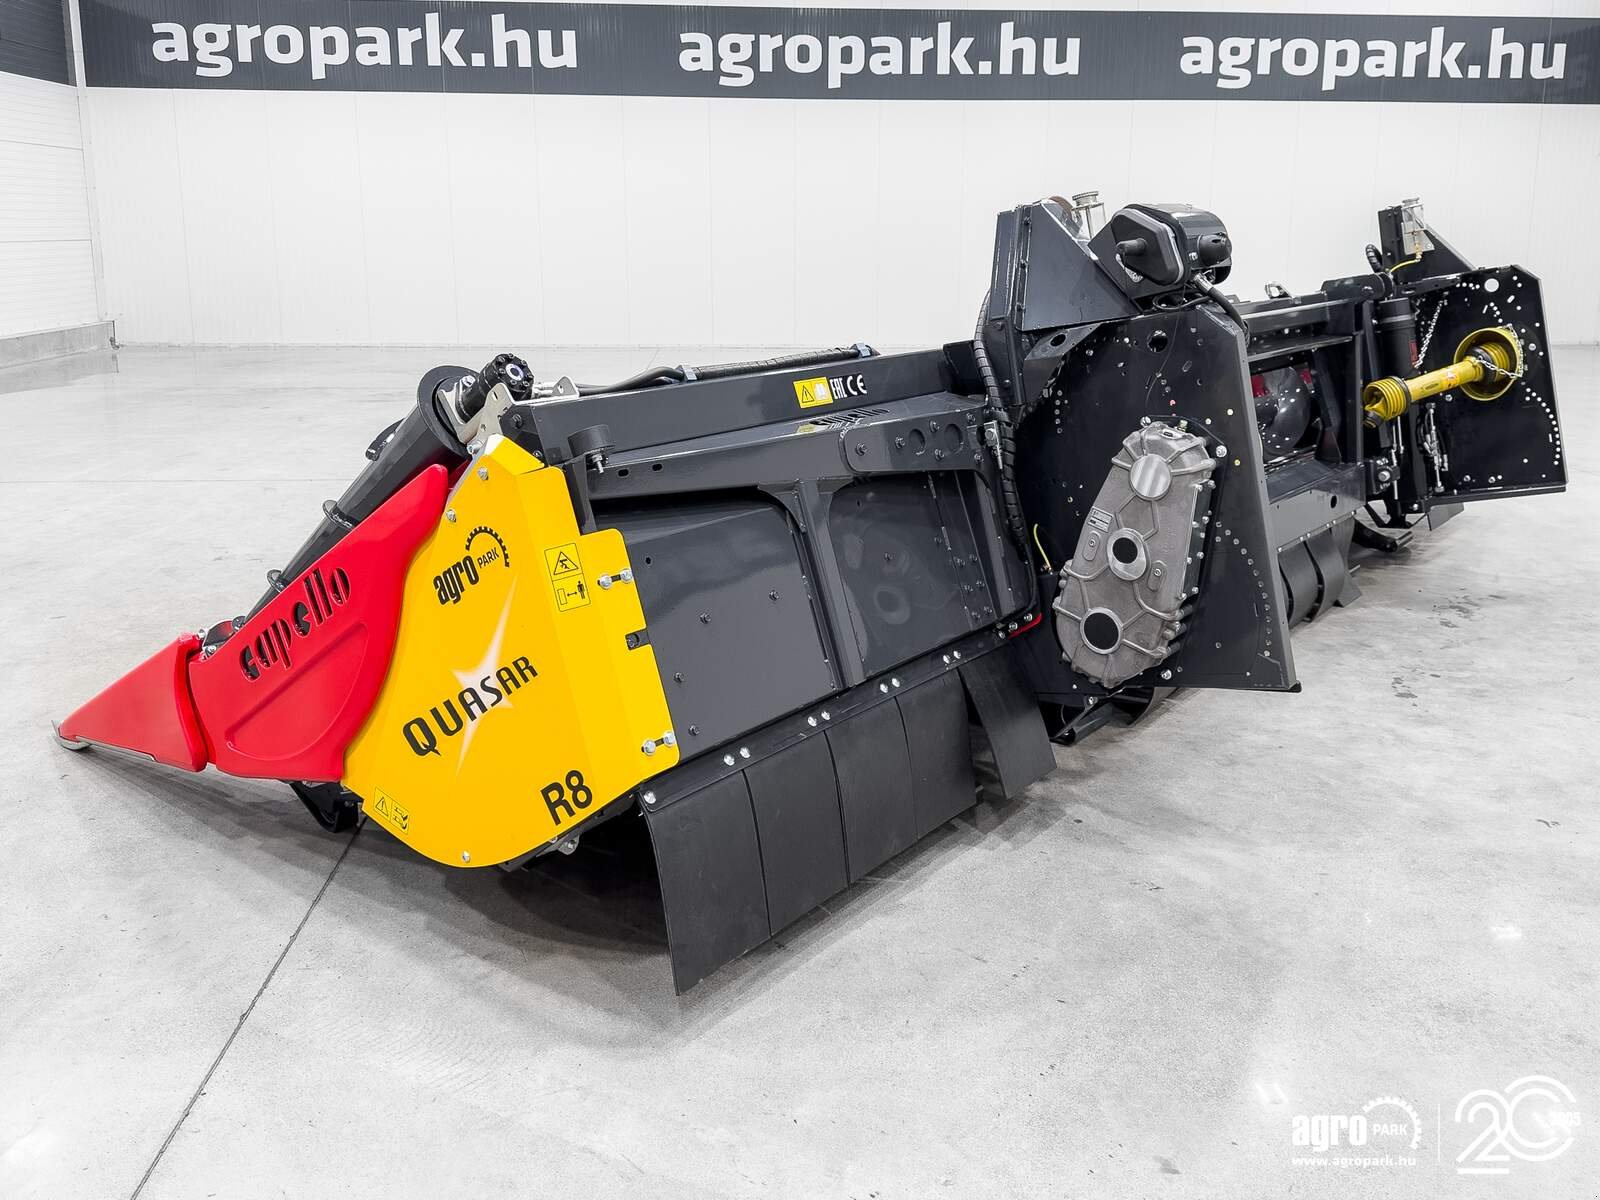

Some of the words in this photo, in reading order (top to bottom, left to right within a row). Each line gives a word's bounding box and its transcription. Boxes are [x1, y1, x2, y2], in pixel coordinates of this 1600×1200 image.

[152, 12, 577, 79] agropark.hu
[679, 21, 1080, 88] agropark.hu
[1179, 26, 1567, 91] agropark.hu
[476, 546, 500, 569] PARK
[402, 656, 539, 757] QUASAR
[540, 769, 593, 826] R8
